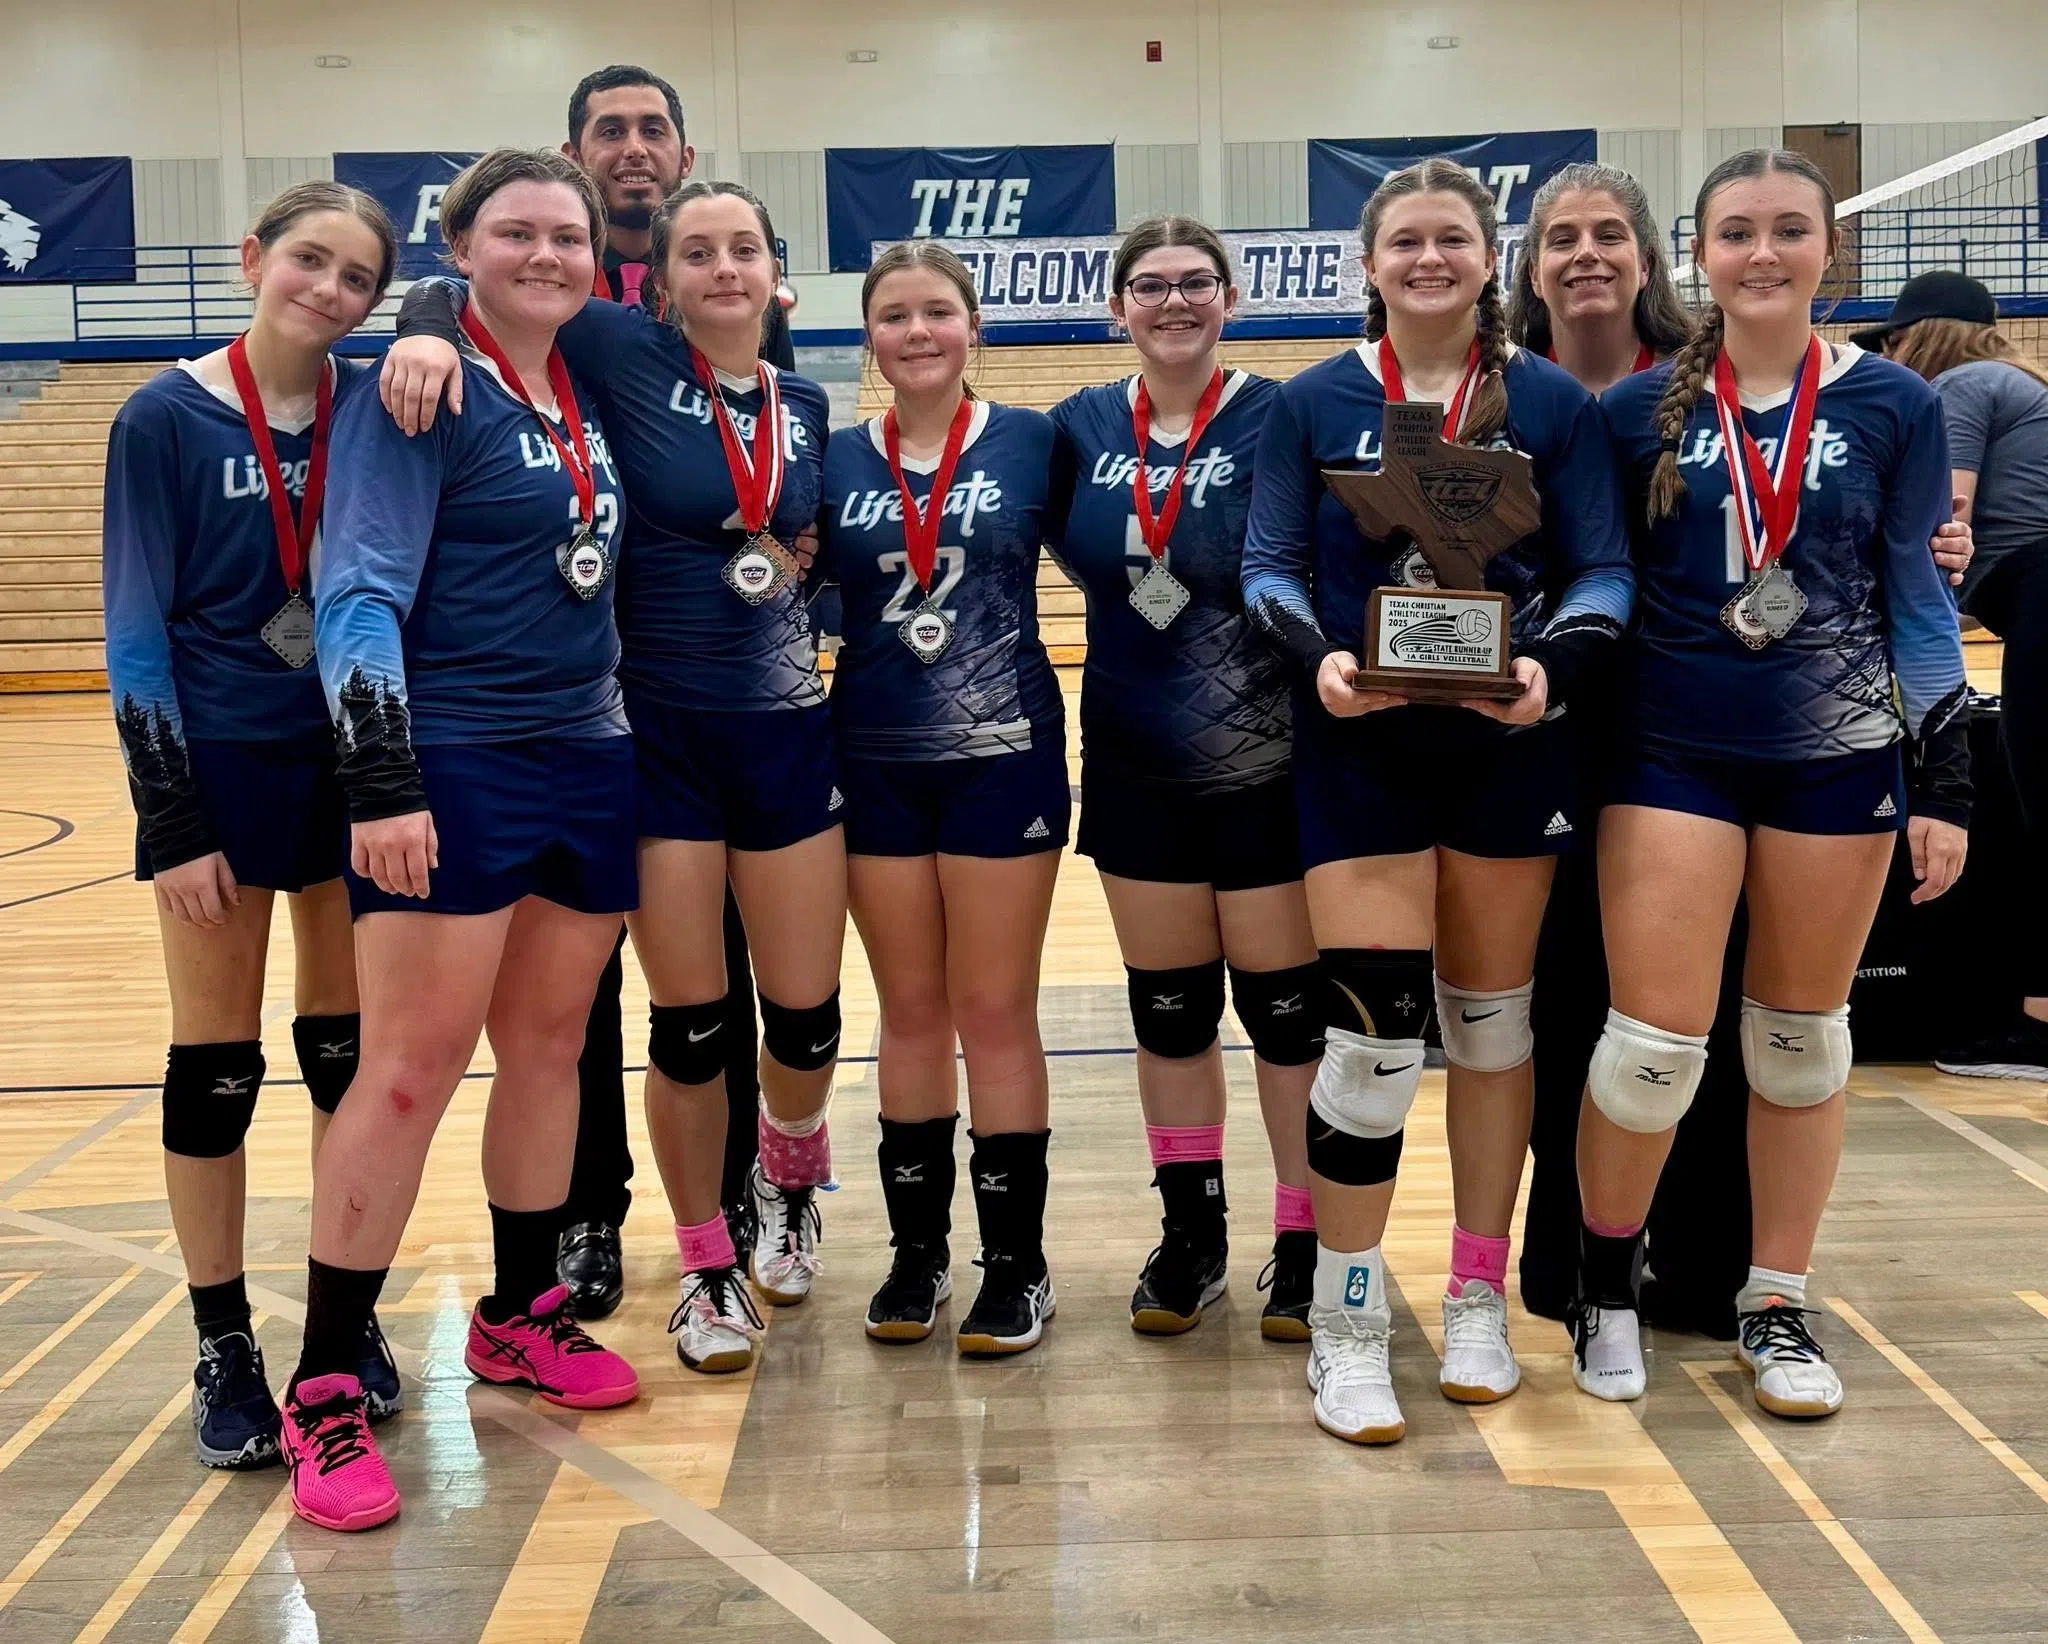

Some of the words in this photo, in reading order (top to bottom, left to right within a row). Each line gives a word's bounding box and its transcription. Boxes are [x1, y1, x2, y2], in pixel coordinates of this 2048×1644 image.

[911, 178, 1030, 237] THE
[1242, 243, 1342, 300] THE
[1396, 411, 1432, 421] TEXAS
[1392, 424, 1434, 433] CHRISTIAN
[1394, 435, 1433, 444] ATHLETIC
[877, 546, 965, 623] 22
[1389, 601, 1409, 609] TEXAS
[1411, 602, 1446, 610] CHRISTIAN
[1388, 610, 1419, 618] ATHLETIC
[1422, 611, 1447, 619] LEAGUE
[1388, 619, 1408, 627] 2025
[1433, 644, 1452, 652] STATE
[1454, 645, 1493, 654] RUNNER-UP
[1443, 655, 1489, 664] VOLLEYBALL
